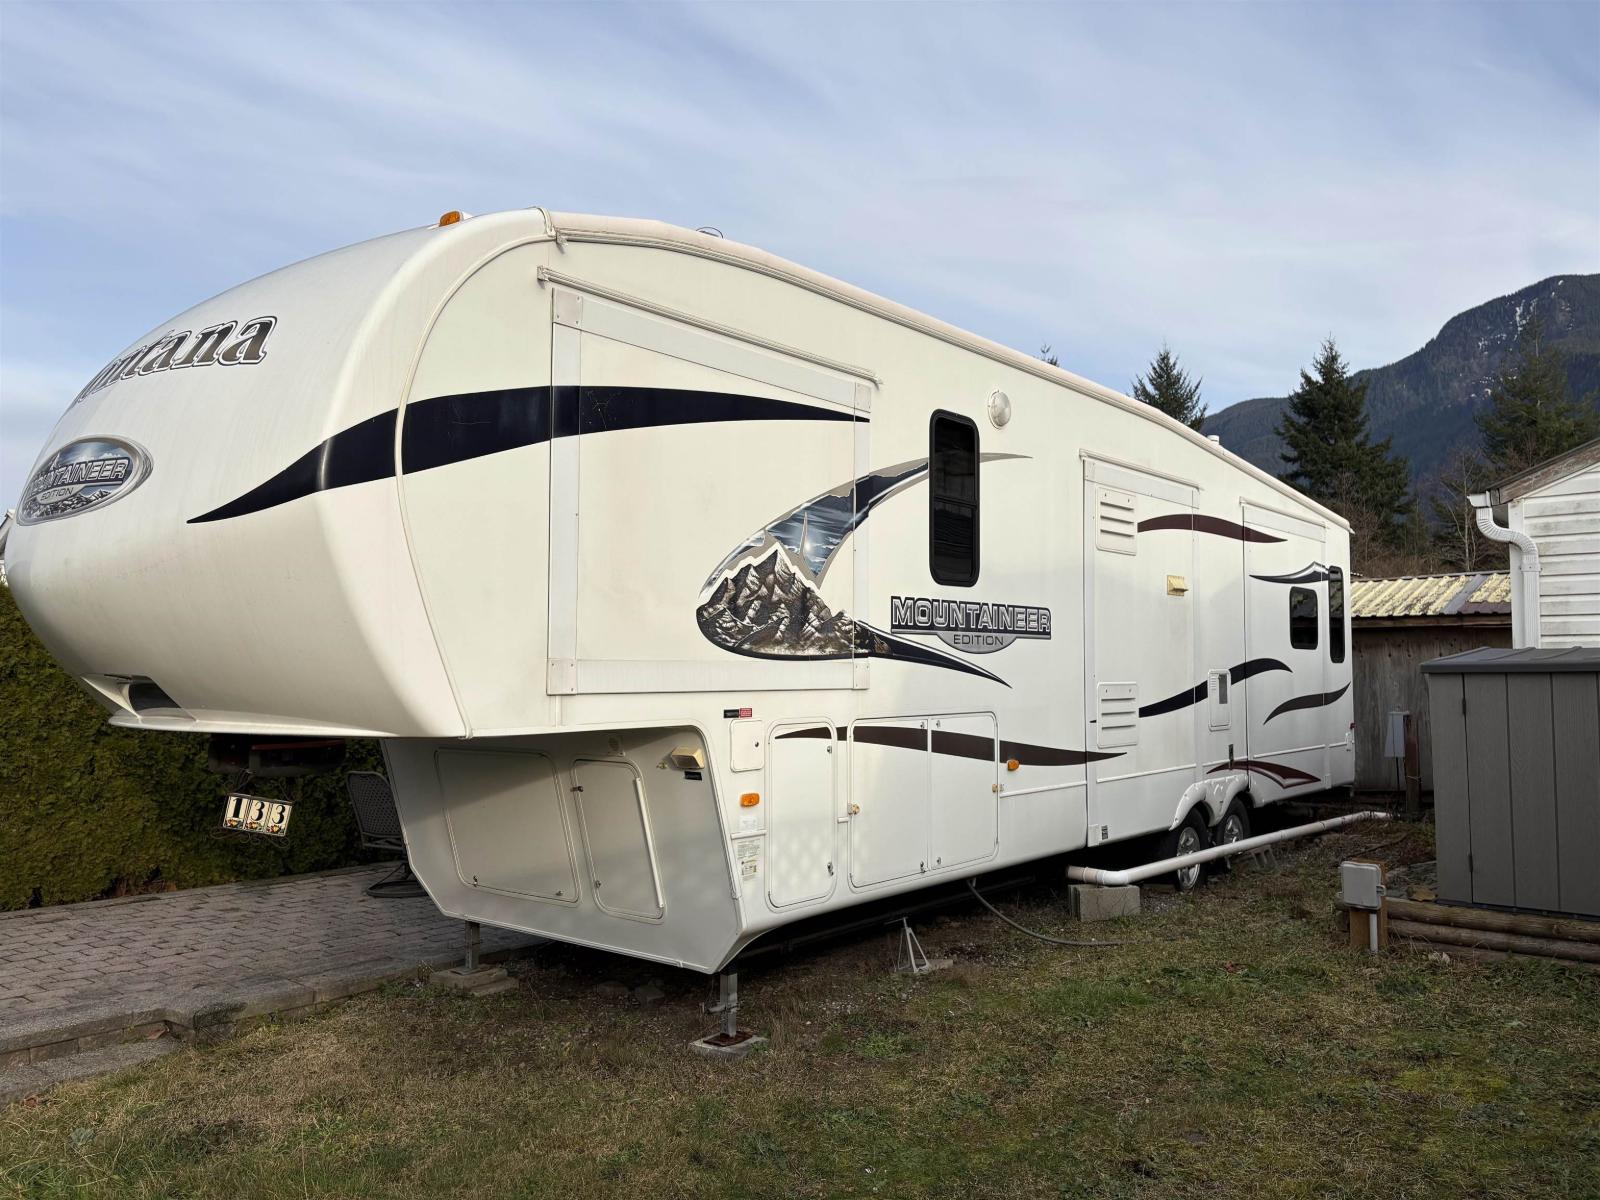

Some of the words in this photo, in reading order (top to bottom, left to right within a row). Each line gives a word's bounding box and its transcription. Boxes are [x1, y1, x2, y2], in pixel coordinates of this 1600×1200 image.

[41, 487, 74, 500] EDITION
[892, 598, 1051, 632] MOUNTAINEER
[953, 633, 1004, 646] EDITION
[232, 798, 286, 825] 133
